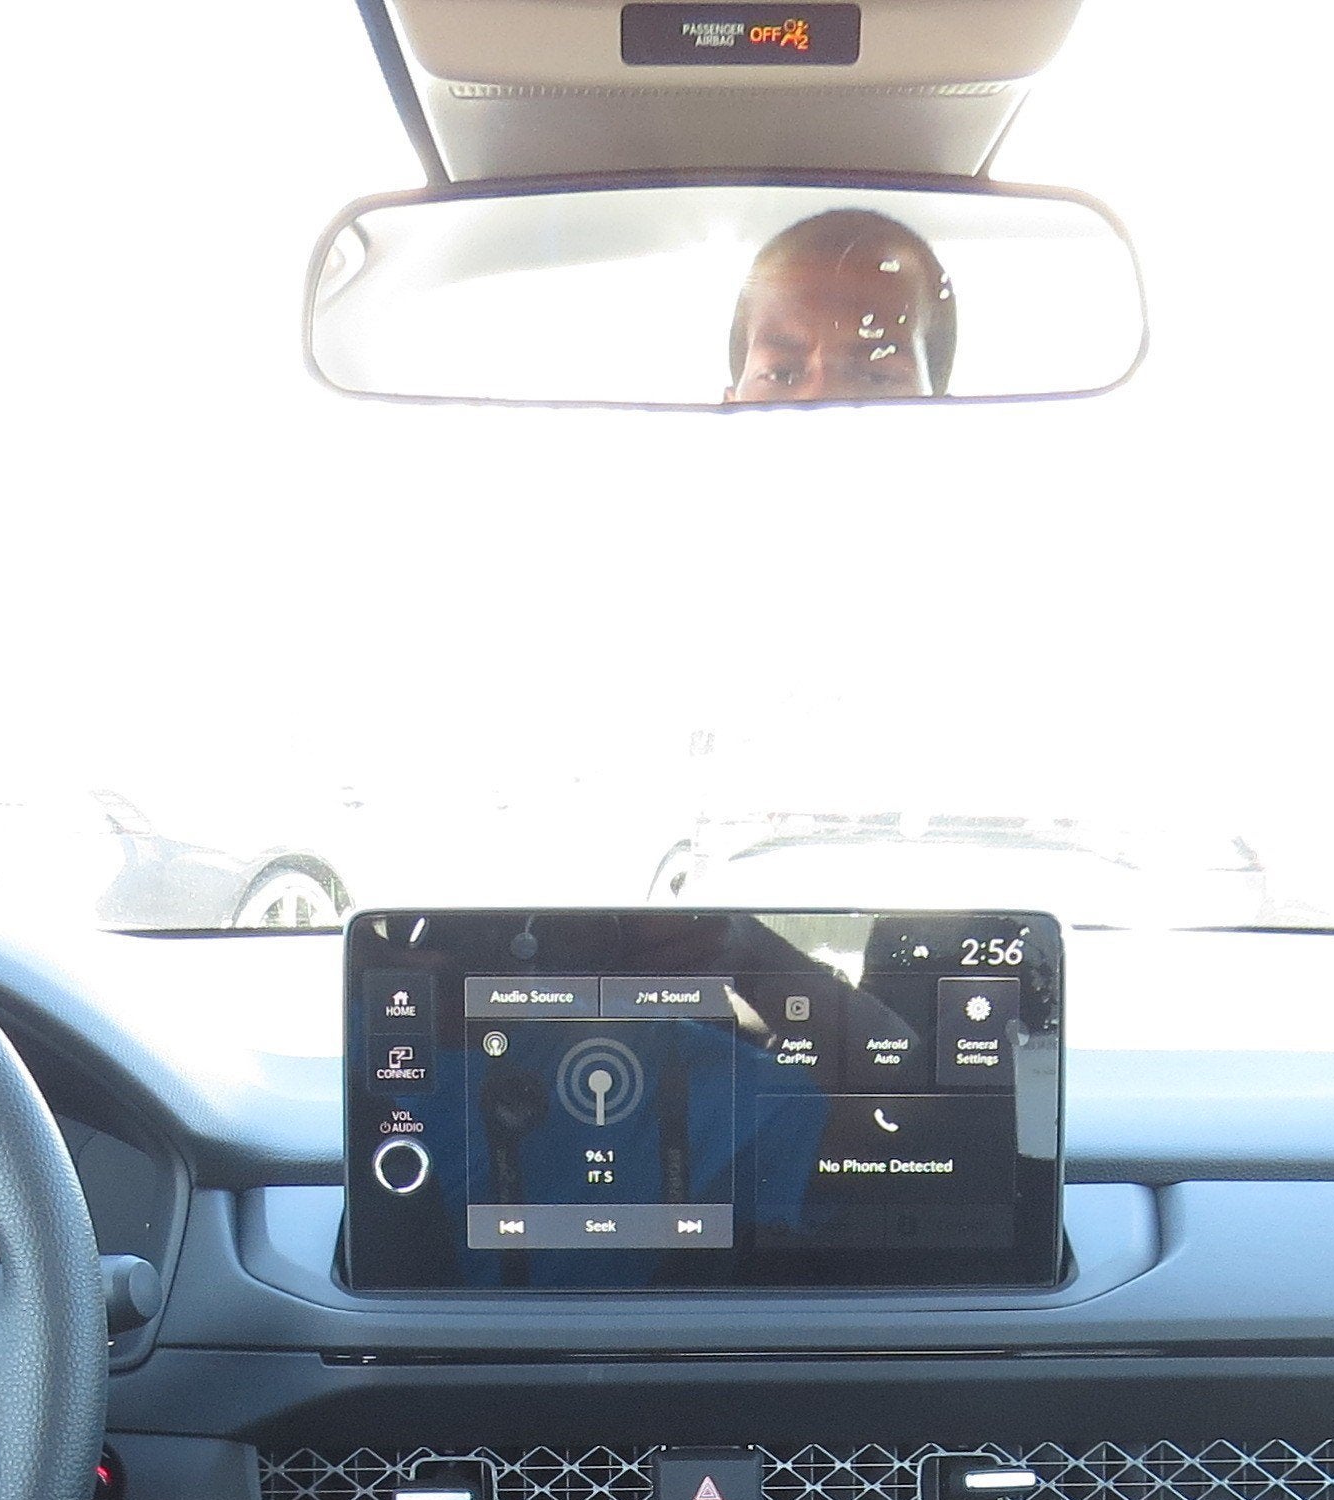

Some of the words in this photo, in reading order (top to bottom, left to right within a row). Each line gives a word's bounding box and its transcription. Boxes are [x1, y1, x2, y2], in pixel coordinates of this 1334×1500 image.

[682, 23, 745, 35] PASSENGER
[750, 26, 782, 42] OFF
[695, 35, 736, 47] AIRBAG
[960, 938, 1023, 966] 2:56
[490, 990, 528, 1003] Audio
[530, 990, 574, 1003] Source
[661, 990, 701, 1003] Sound
[385, 1006, 416, 1017] HOME
[781, 1038, 813, 1051] Apple
[867, 1038, 908, 1050] Android
[957, 1038, 998, 1050] General
[776, 1053, 818, 1067] CarPlay
[874, 1053, 900, 1065] Auto
[956, 1053, 999, 1067] Settings
[376, 1068, 426, 1080] CONNECT
[391, 1111, 413, 1121] VOL
[392, 1122, 424, 1133] AUDIO
[585, 1150, 614, 1163] 96.1
[819, 1160, 840, 1173] No
[843, 1160, 887, 1173] Phone
[889, 1160, 953, 1173] Detected
[587, 1171, 601, 1183] IT
[604, 1171, 614, 1183] S
[585, 1220, 617, 1233] Seek
